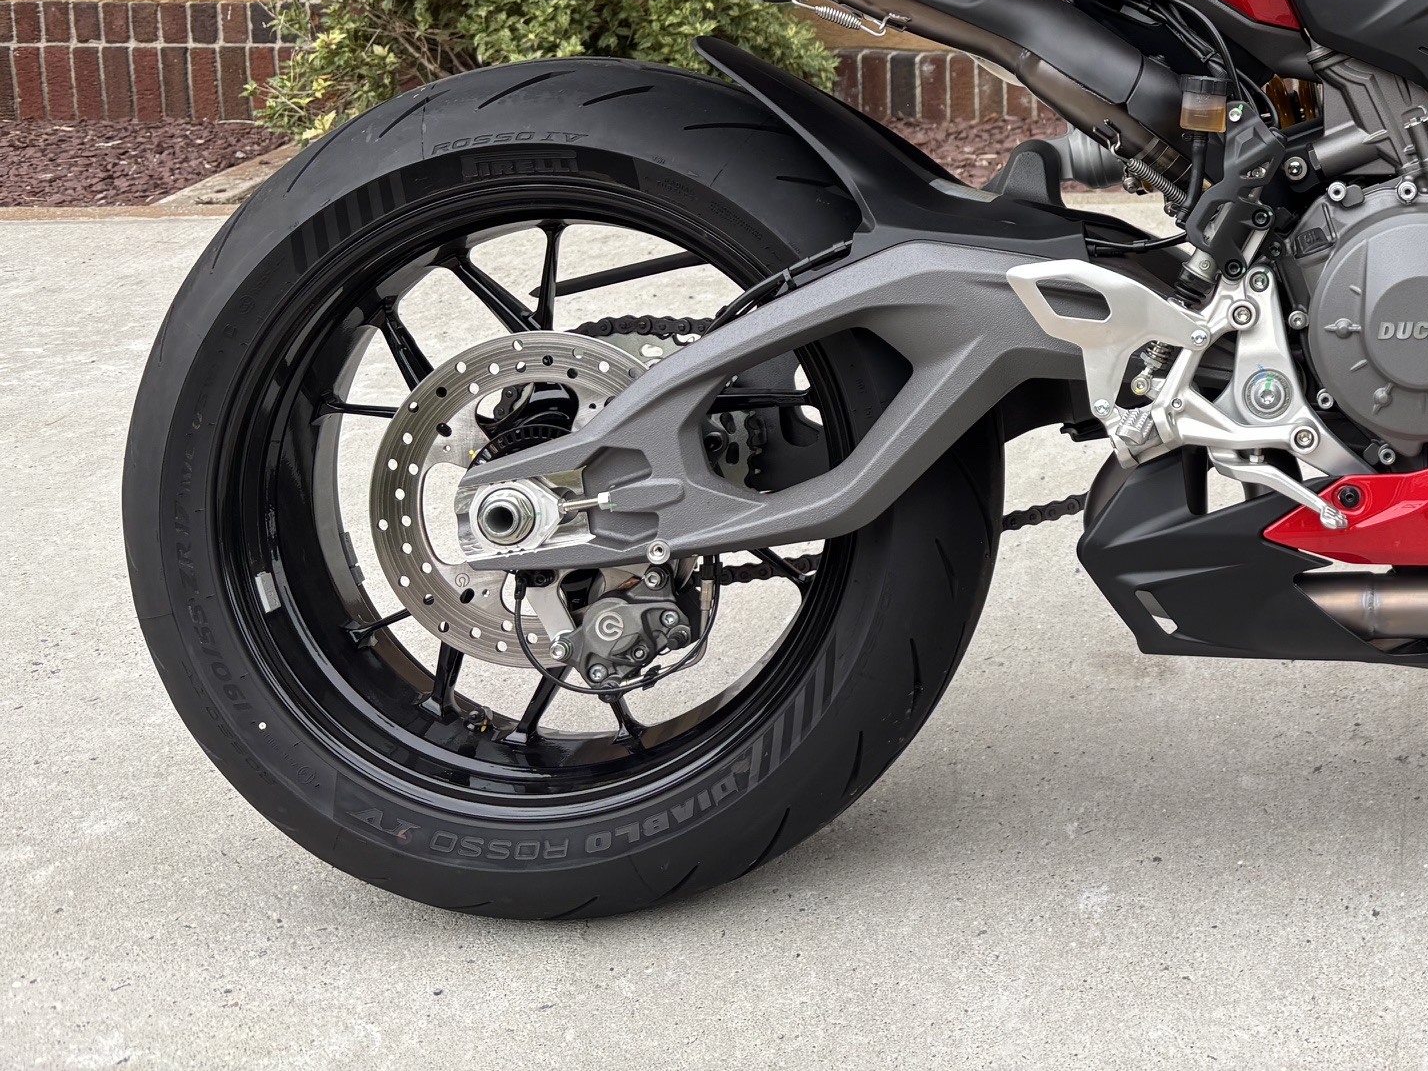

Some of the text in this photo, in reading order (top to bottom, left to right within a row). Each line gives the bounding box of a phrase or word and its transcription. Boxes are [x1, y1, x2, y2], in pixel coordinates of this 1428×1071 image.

[432, 132, 535, 156] ROSSO
[349, 772, 740, 860] DIABLO ROSSO IV
